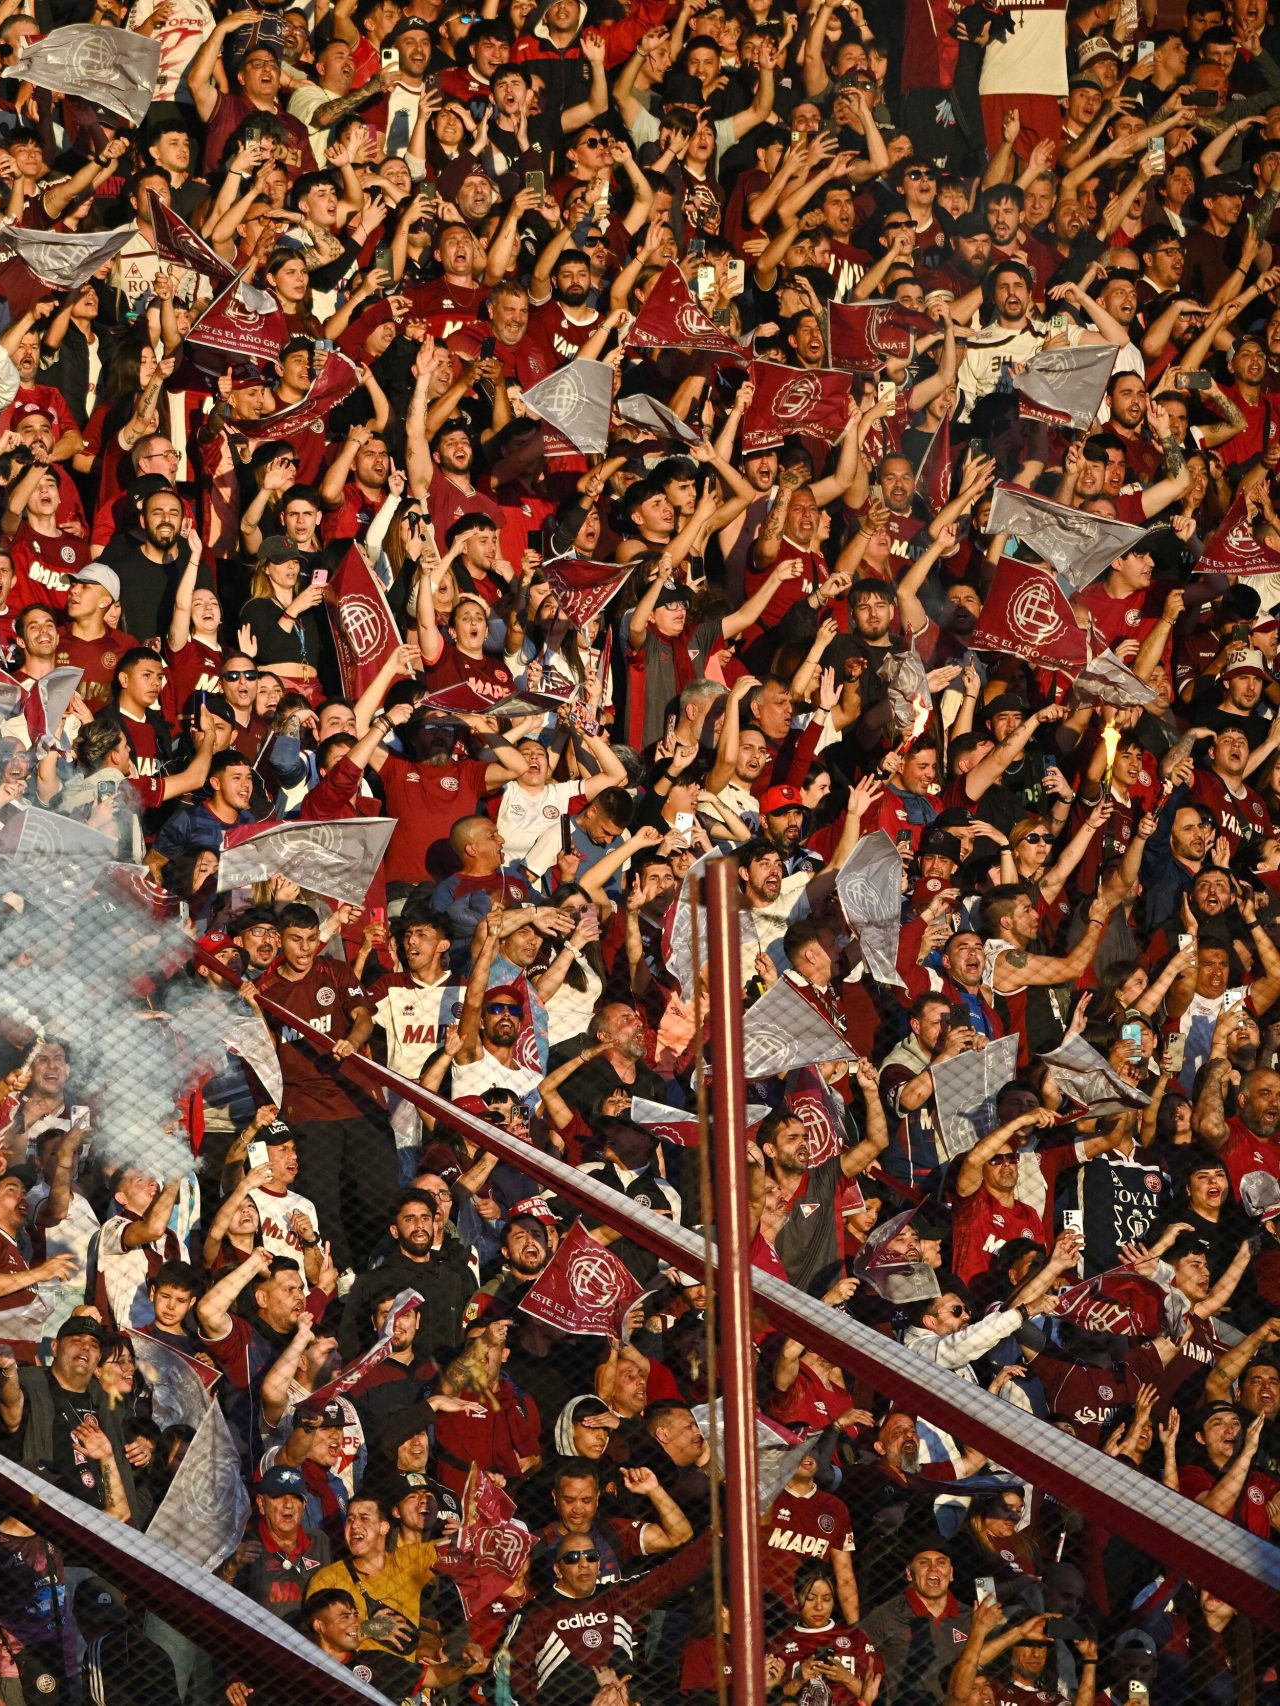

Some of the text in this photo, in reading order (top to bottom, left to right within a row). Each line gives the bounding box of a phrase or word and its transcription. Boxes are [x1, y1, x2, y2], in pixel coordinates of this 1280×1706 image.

[212, 327, 223, 336] ES
[225, 330, 237, 339] EL
[239, 333, 261, 344] AÑO
[1001, 639, 1013, 649] EL
[530, 1291, 552, 1307] ESTE
[554, 1302, 566, 1314] ES
[566, 1310, 579, 1321] EL
[767, 1527, 830, 1560] MAPEI
